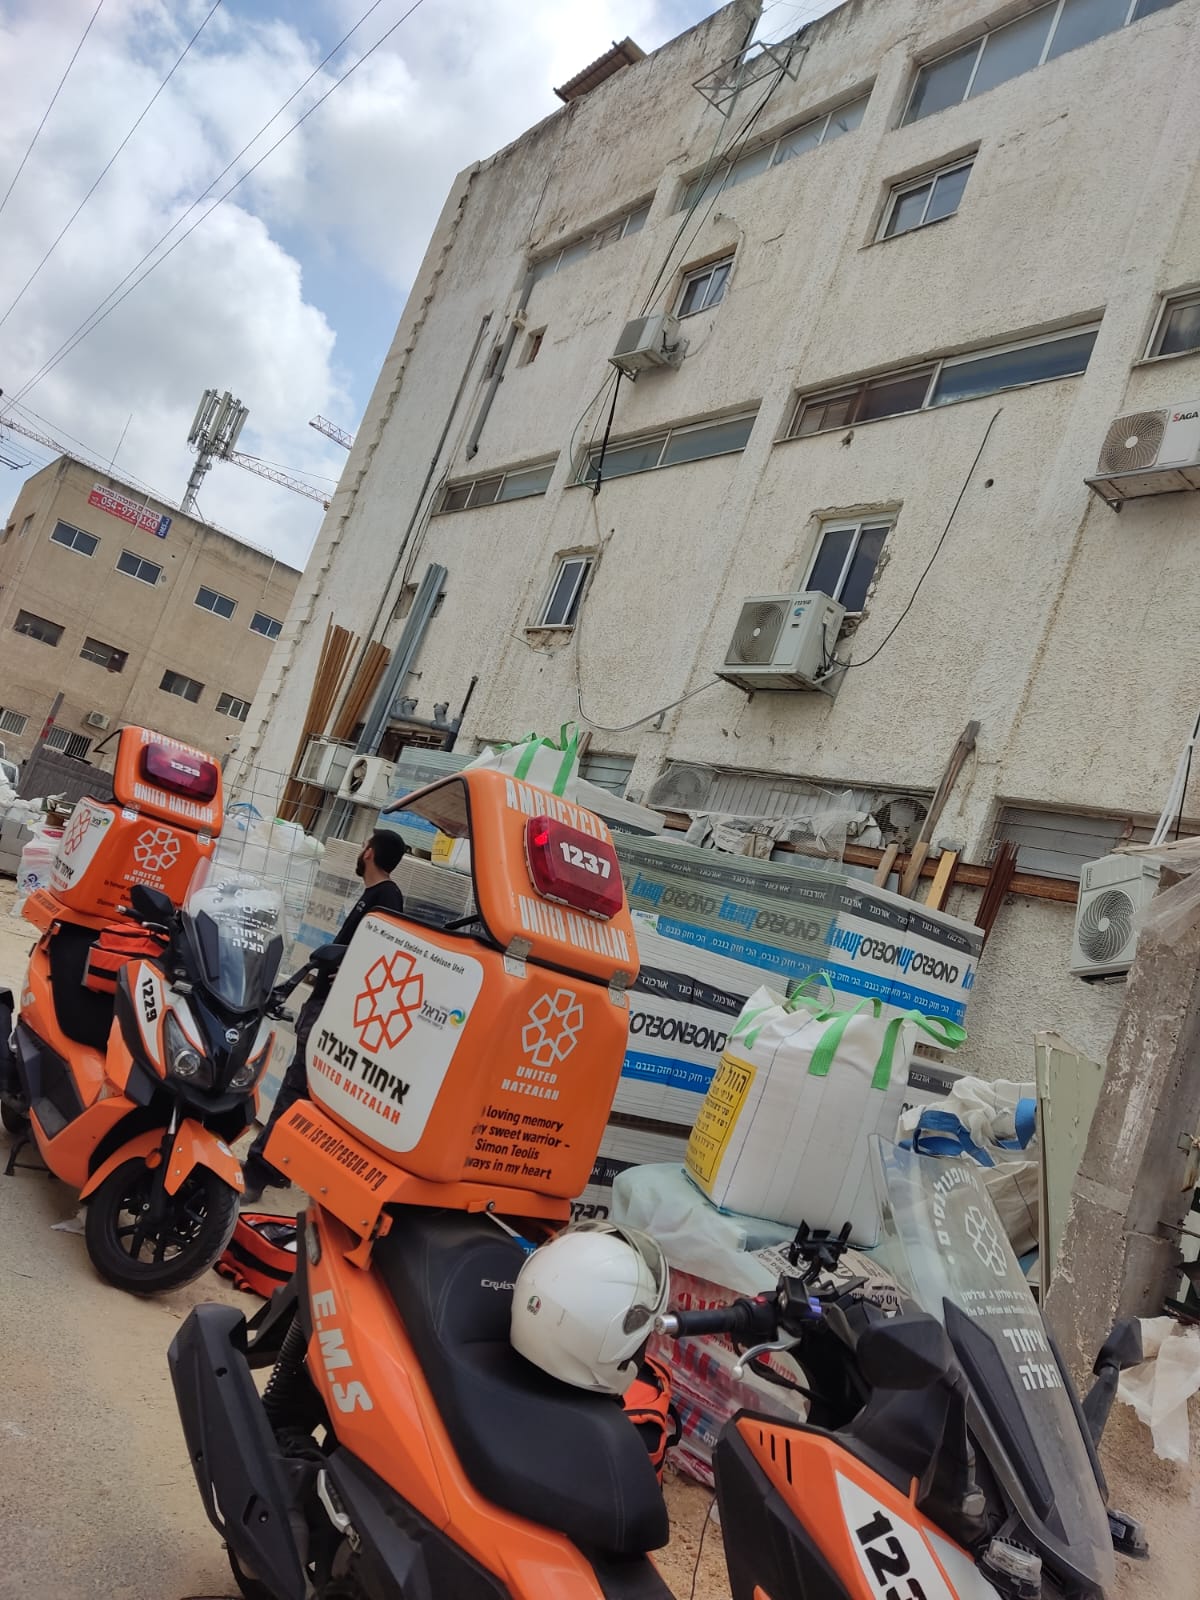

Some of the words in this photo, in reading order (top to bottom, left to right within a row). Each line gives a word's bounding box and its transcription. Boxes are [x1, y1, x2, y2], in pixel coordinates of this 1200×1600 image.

[1173, 411, 1199, 422] SAGA
[170, 761, 200, 777] 1229
[134, 782, 166, 807] UNITED
[169, 794, 213, 824] HATZALAH
[505, 778, 608, 841] AMBUCYCLE
[560, 842, 611, 879] 1237
[123, 874, 165, 890] HATZALAH
[132, 870, 162, 882] UNITED
[231, 925, 264, 942] איחוד
[518, 894, 567, 943] UNITED
[567, 912, 630, 962] HATZALAH
[682, 931, 695, 942] חזק
[232, 937, 264, 954] הצלה
[380, 930, 395, 942] Miriam
[394, 937, 405, 947] and
[403, 941, 423, 956] Sheldon
[430, 953, 452, 969] Adelson
[452, 963, 465, 975] Unit
[730, 942, 744, 953] חזק
[746, 948, 757, 958] הכי
[781, 956, 796, 968] חזק
[797, 961, 810, 972] הכי
[911, 953, 959, 984] ORBOND
[837, 972, 850, 983] חזק
[851, 976, 861, 987] הכי
[142, 978, 157, 1023] 1229
[712, 993, 738, 1007] אורבונד
[421, 1000, 448, 1025] הראל
[316, 1029, 358, 1072] הצלה
[360, 1056, 410, 1105] איחוד
[516, 1066, 557, 1084] UNITED
[688, 1072, 703, 1084] חזק
[312, 1055, 342, 1086] UNITED
[343, 1079, 401, 1126] HATZALAH
[501, 1079, 560, 1101] HATZALAH
[487, 1105, 520, 1126] loving
[521, 1115, 564, 1132] memory
[489, 1125, 521, 1140] sweet
[522, 1133, 562, 1148] warrior
[288, 1112, 388, 1192] www.israelrescue.org
[475, 1138, 508, 1155] Simon
[510, 1144, 540, 1160] Teolis
[493, 1158, 503, 1172] in
[505, 1162, 520, 1175] my
[521, 1162, 552, 1180] heart
[312, 1289, 374, 1413] E.M.S
[1003, 1328, 1048, 1353] איחוד
[1019, 1358, 1061, 1391] הצלה
